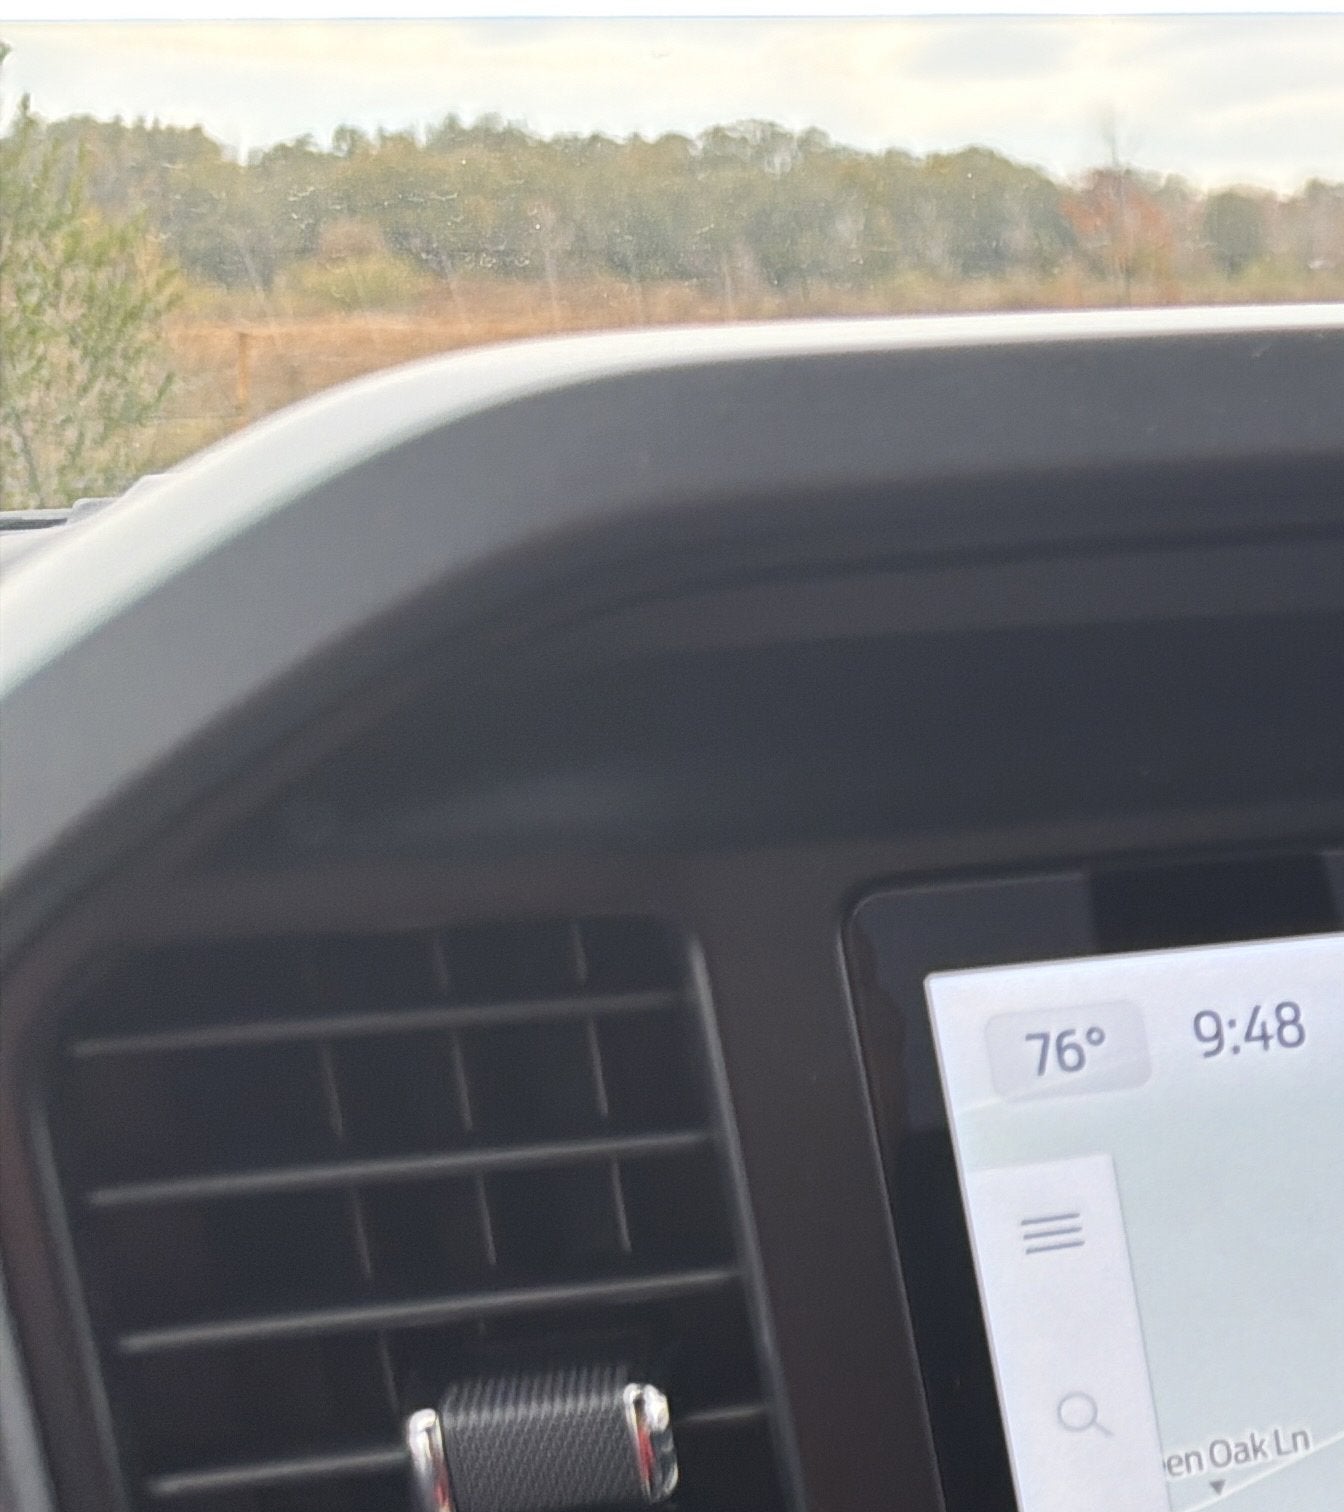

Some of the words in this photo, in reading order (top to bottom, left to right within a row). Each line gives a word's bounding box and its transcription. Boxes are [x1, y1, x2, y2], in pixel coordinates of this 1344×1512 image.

[1025, 1026, 1106, 1076] 76°
[1192, 1002, 1307, 1057] 9:48
[1161, 1449, 1204, 1477] en
[1208, 1432, 1269, 1468] Oak
[1274, 1428, 1311, 1456] Ln
